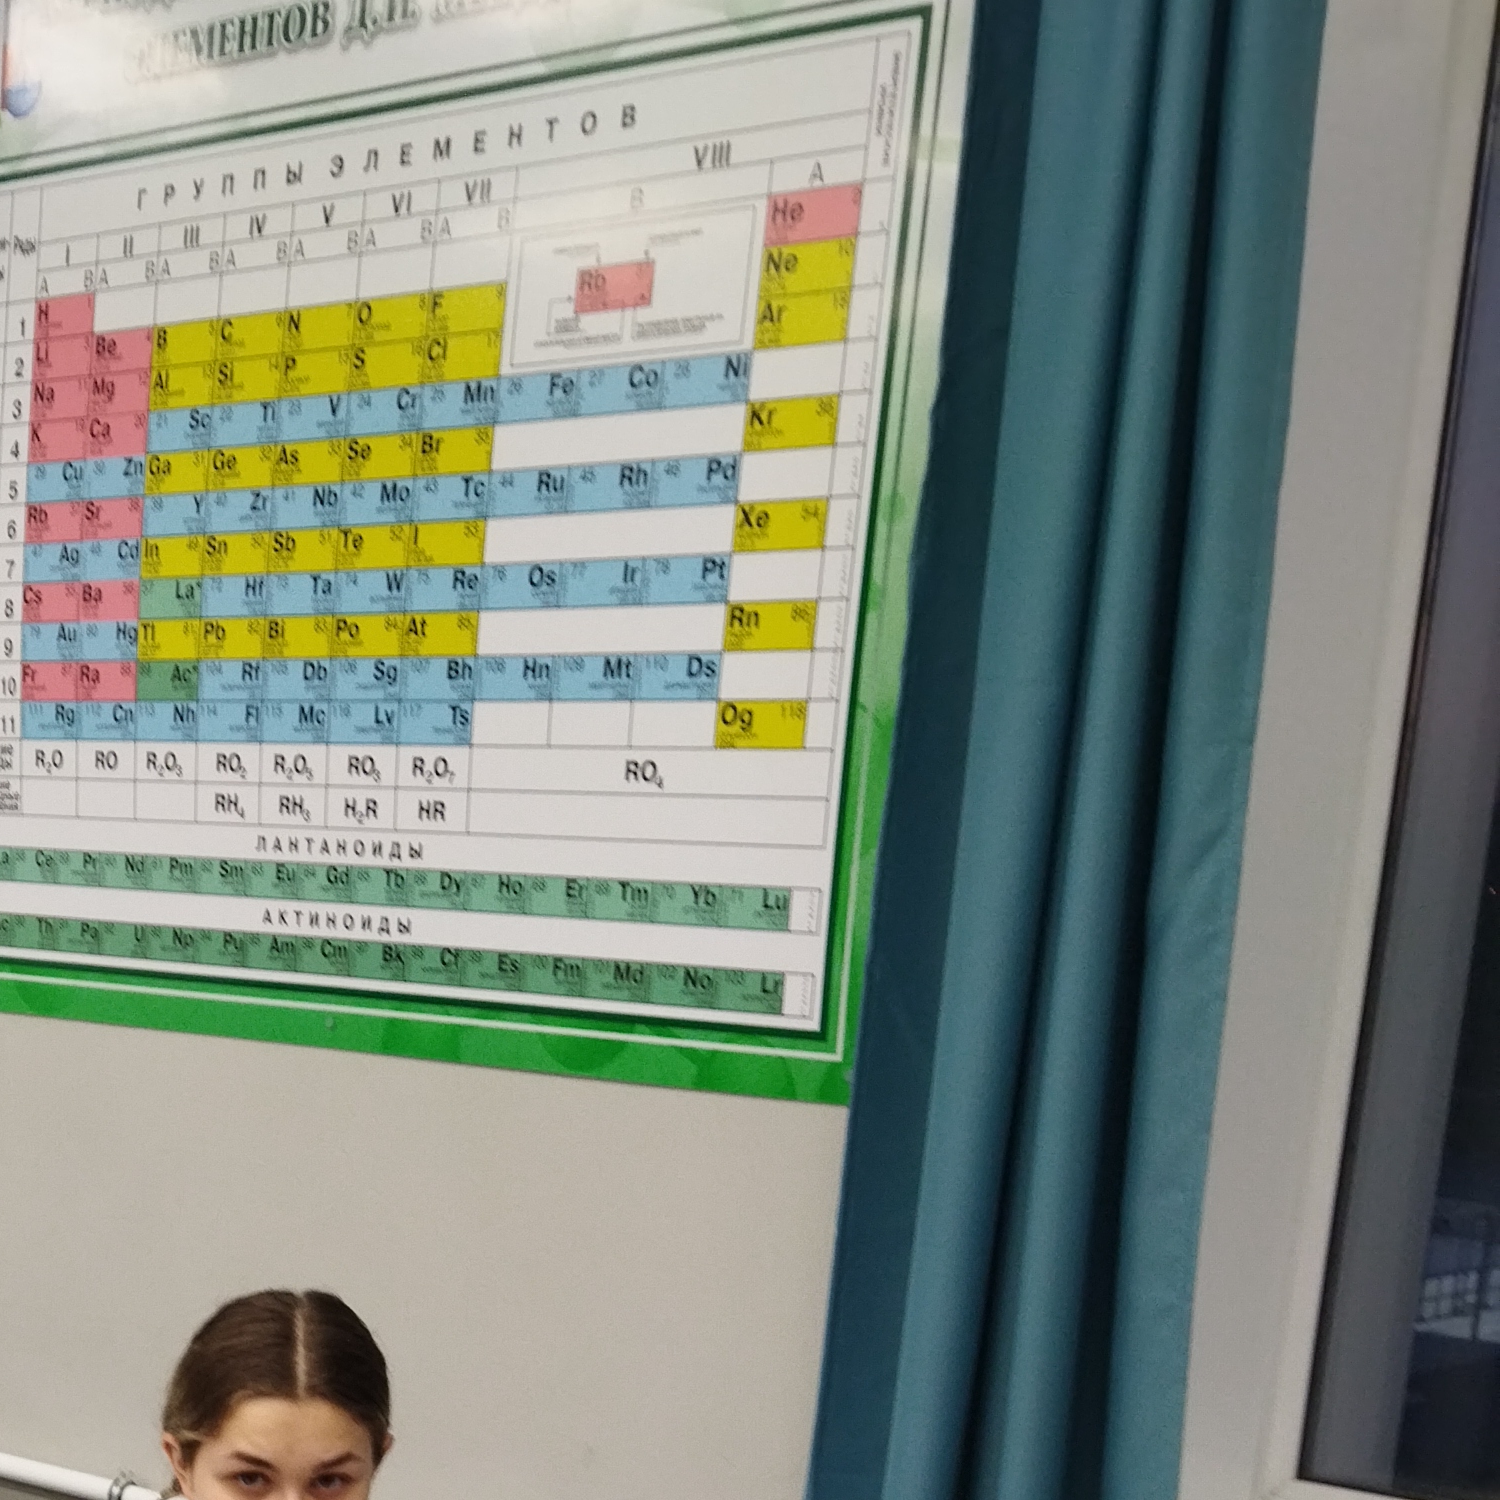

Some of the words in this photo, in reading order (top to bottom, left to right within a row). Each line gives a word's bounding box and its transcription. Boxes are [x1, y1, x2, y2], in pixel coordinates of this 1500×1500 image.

[137, 160, 303, 211] ГРУППЫ
[329, 103, 637, 178] ЭЛЕМЕНТОВ
[809, 159, 824, 186] A
[123, 235, 134, 259] II
[184, 224, 200, 249] III
[249, 213, 267, 239] IV
[322, 202, 335, 227] V
[392, 190, 412, 217] VI
[465, 177, 491, 204] VII
[693, 139, 732, 170] VIII
[20, 317, 26, 337] 1
[38, 303, 48, 322] H
[772, 199, 805, 225] He
[15, 357, 24, 378] 2
[95, 336, 117, 355] Be
[156, 327, 167, 349] B
[221, 319, 234, 342] C
[287, 310, 300, 333] N
[357, 301, 372, 325] O
[766, 249, 798, 274] Ne
[12, 398, 22, 420] 3
[34, 384, 54, 403] Na
[93, 377, 115, 402] Mg
[155, 369, 169, 391] Al
[218, 361, 233, 385] Si
[284, 355, 295, 376] P
[353, 347, 366, 369] S
[427, 338, 447, 363] Cl
[760, 303, 786, 325] Ar
[10, 440, 20, 459] 4
[31, 423, 41, 443] K
[90, 418, 111, 440] Ca
[189, 409, 212, 430] Sc
[328, 395, 341, 417] V
[397, 388, 416, 410] Cr
[464, 381, 495, 404] Mn
[549, 373, 575, 396] Fe
[629, 364, 658, 388] Co
[724, 353, 748, 379] Ni
[8, 480, 18, 500] 5
[62, 461, 83, 482] Cu
[123, 456, 143, 477] Zn
[149, 455, 171, 477] Ga
[213, 449, 237, 471] Ge
[278, 445, 299, 465] As
[347, 438, 372, 461] Se
[421, 433, 444, 455] Br
[7, 519, 17, 540] 6
[28, 505, 48, 525] Rb
[313, 486, 338, 507] Nb
[380, 481, 410, 503] Mo
[462, 476, 485, 499] Tc
[537, 469, 565, 493] Ru
[619, 464, 648, 487] Rh
[707, 457, 737, 482] Pd
[5, 559, 15, 579] 7
[118, 539, 139, 560] Cd
[144, 537, 159, 558] In
[205, 534, 228, 557] Sn
[273, 532, 295, 553] Sb
[339, 527, 364, 550] Te
[4, 597, 14, 619] 8
[23, 586, 42, 606] Cs
[82, 583, 102, 603] Ba
[311, 573, 332, 595] Ta
[386, 571, 404, 594] W
[452, 569, 479, 590] Re
[528, 563, 557, 588] Os
[703, 558, 725, 580] Pt
[4, 637, 13, 658] 9
[57, 621, 77, 642] Au
[116, 621, 137, 647] Hg
[203, 620, 226, 641] Pb
[268, 621, 285, 641] Bi
[336, 619, 359, 639] Po
[406, 617, 427, 637] At
[730, 605, 759, 628] Rn
[1, 677, 16, 696] 10
[79, 664, 100, 684] Ra
[303, 661, 327, 681] Db
[373, 659, 397, 685] Sg
[447, 659, 473, 680] Bh
[603, 658, 632, 679] Mt
[687, 655, 716, 678] Ds
[1, 716, 15, 736] 11
[55, 703, 75, 727] Rg
[112, 704, 134, 724] Cn
[173, 702, 195, 723] Nh
[299, 704, 325, 726] Mc
[374, 703, 395, 725] Lv
[450, 705, 469, 726] Ts
[721, 702, 753, 733] Og
[95, 750, 117, 770] RO
[418, 800, 446, 821] HR
[255, 835, 423, 862] ЛАНТАНОИДЫ
[327, 865, 348, 885] Gd
[263, 908, 412, 937] АКТИНОИДЫ
